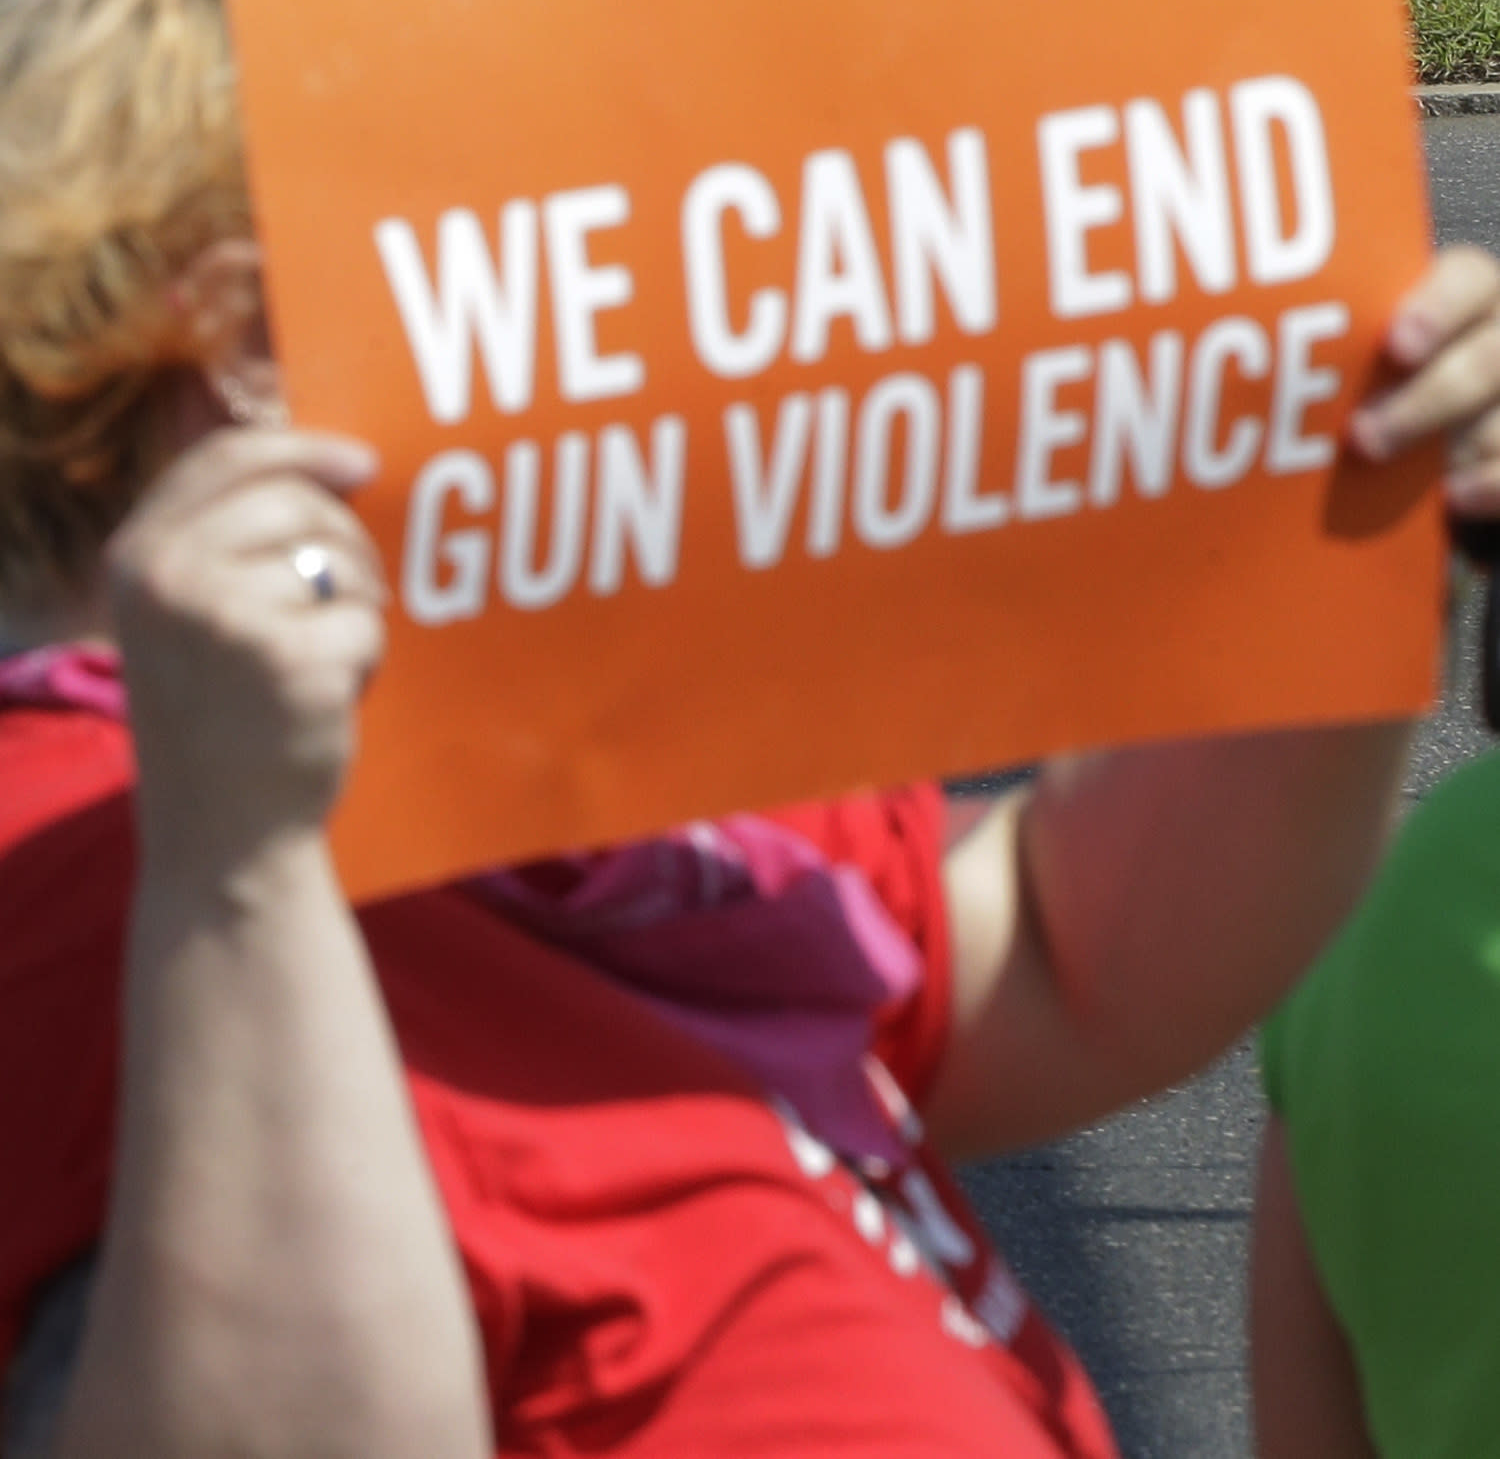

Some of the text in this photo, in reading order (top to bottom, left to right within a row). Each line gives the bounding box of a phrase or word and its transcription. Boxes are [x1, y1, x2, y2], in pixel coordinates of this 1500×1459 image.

[375, 73, 1337, 426] WE CAN END
[404, 301, 1350, 627] GUN VIOLENCE
